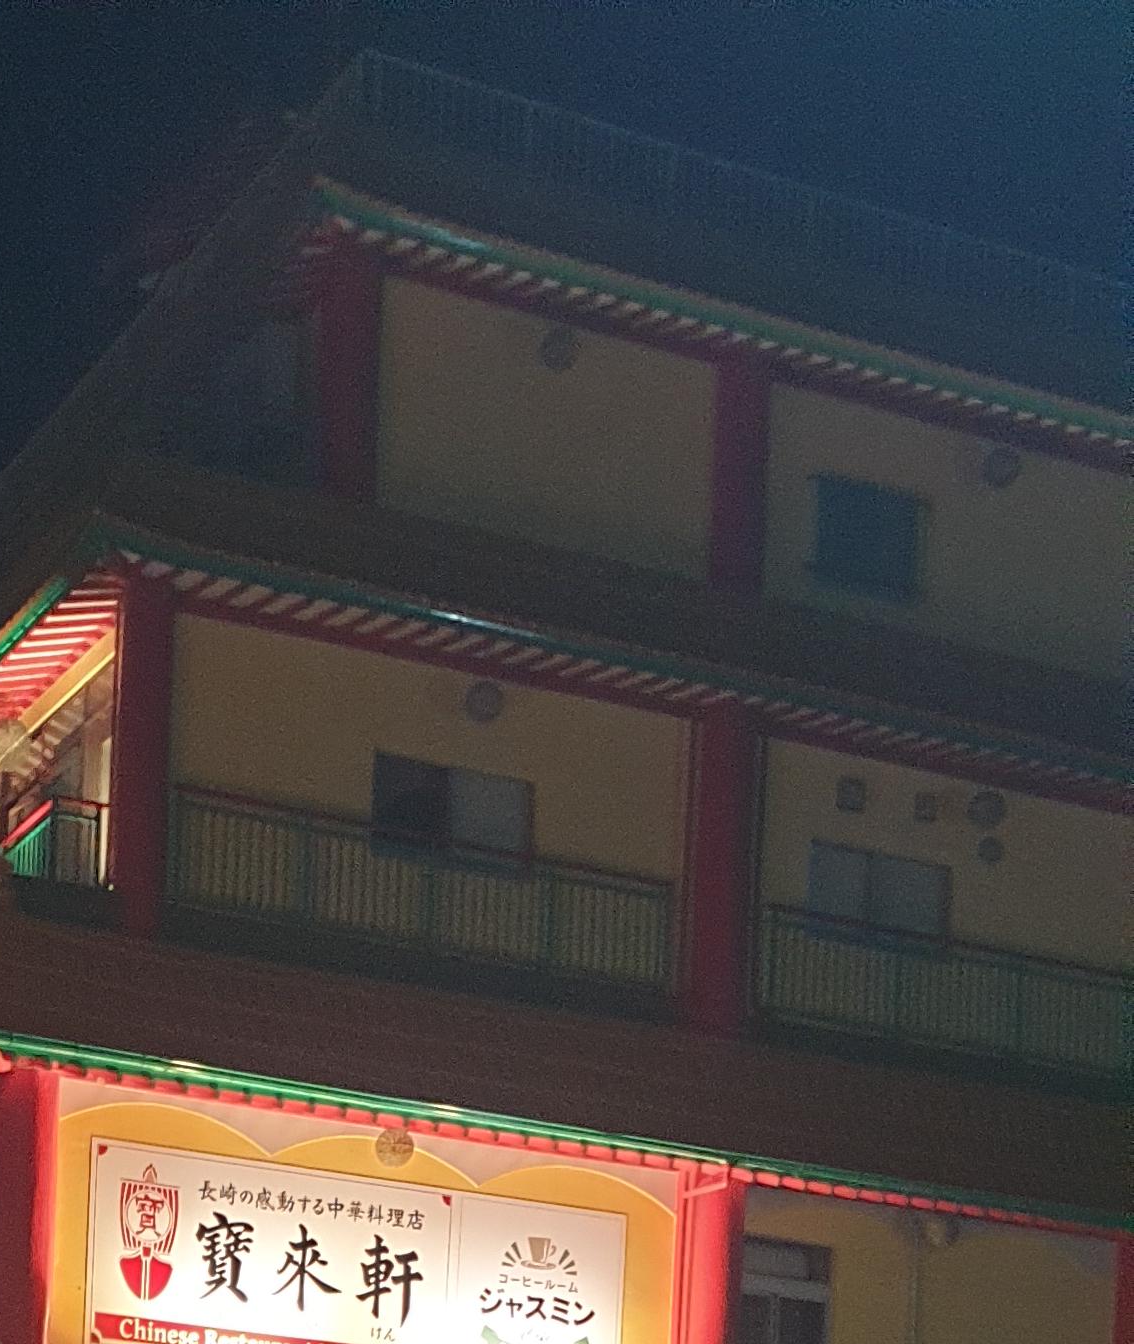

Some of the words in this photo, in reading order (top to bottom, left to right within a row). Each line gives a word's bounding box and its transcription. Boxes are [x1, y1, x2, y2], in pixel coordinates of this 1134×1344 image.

[198, 1179, 426, 1231] 長崎の感動する中華料理店
[195, 1211, 424, 1328] 寶來軒
[498, 1273, 579, 1294] コーヒールーム
[479, 1287, 596, 1326] ジャスミン
